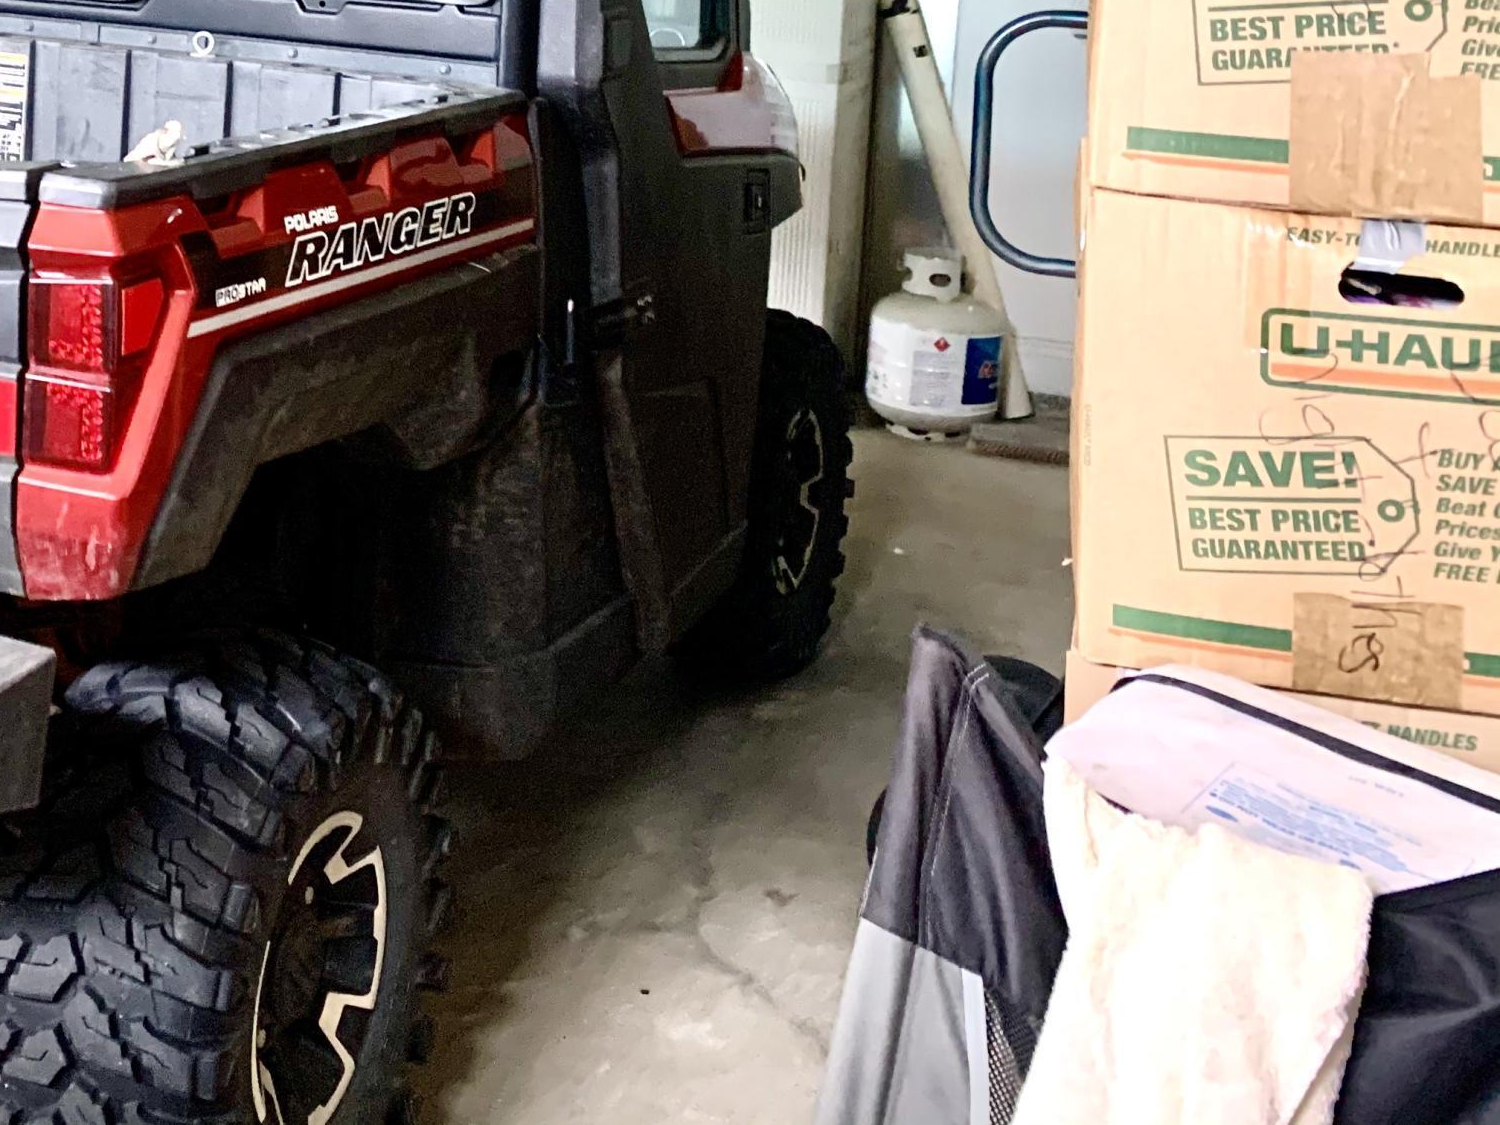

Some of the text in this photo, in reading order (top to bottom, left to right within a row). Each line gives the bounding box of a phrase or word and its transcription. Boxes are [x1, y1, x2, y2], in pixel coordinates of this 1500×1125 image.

[1209, 11, 1387, 42] BEST PRICE
[284, 206, 339, 235] POLARIS
[285, 191, 476, 288] RANGER
[215, 277, 267, 307] PROSTAR
[1184, 449, 1359, 489] SAVE!
[1436, 473, 1498, 496] SAVE
[1188, 507, 1361, 534] BEST PRICE
[1436, 497, 1487, 518] Beat
[1434, 540, 1482, 561] Give
[1433, 562, 1491, 584] FREE
